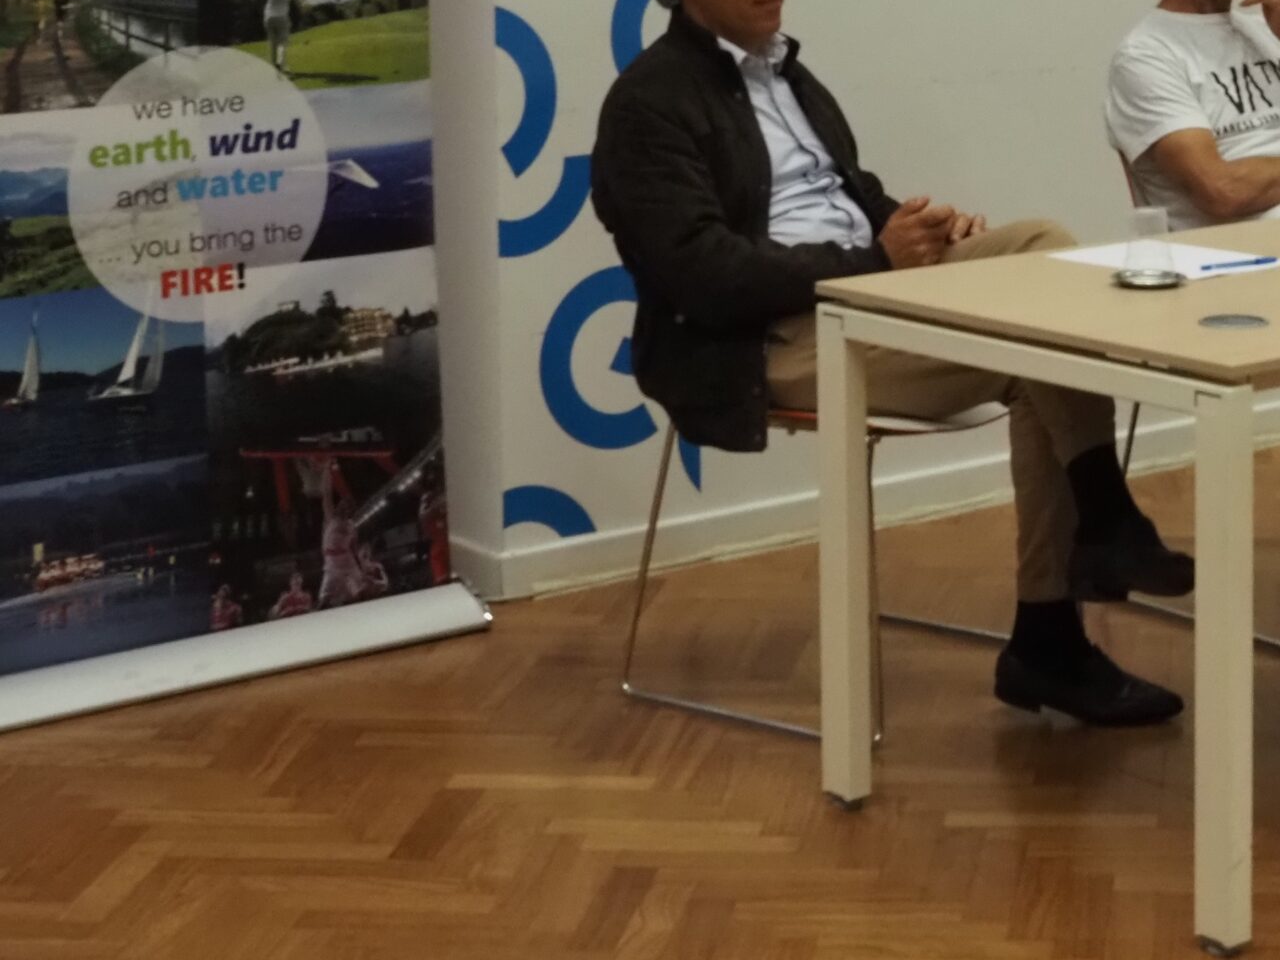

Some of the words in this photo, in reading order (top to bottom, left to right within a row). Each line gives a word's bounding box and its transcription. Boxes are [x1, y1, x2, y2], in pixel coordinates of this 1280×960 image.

[131, 100, 172, 120] we
[181, 96, 245, 117] have
[209, 118, 300, 157] wind
[116, 183, 169, 209] and
[176, 168, 284, 202] water
[131, 239, 180, 265] you
[189, 230, 255, 253] bring
[264, 223, 303, 245] the
[161, 262, 246, 299] FIRE!
